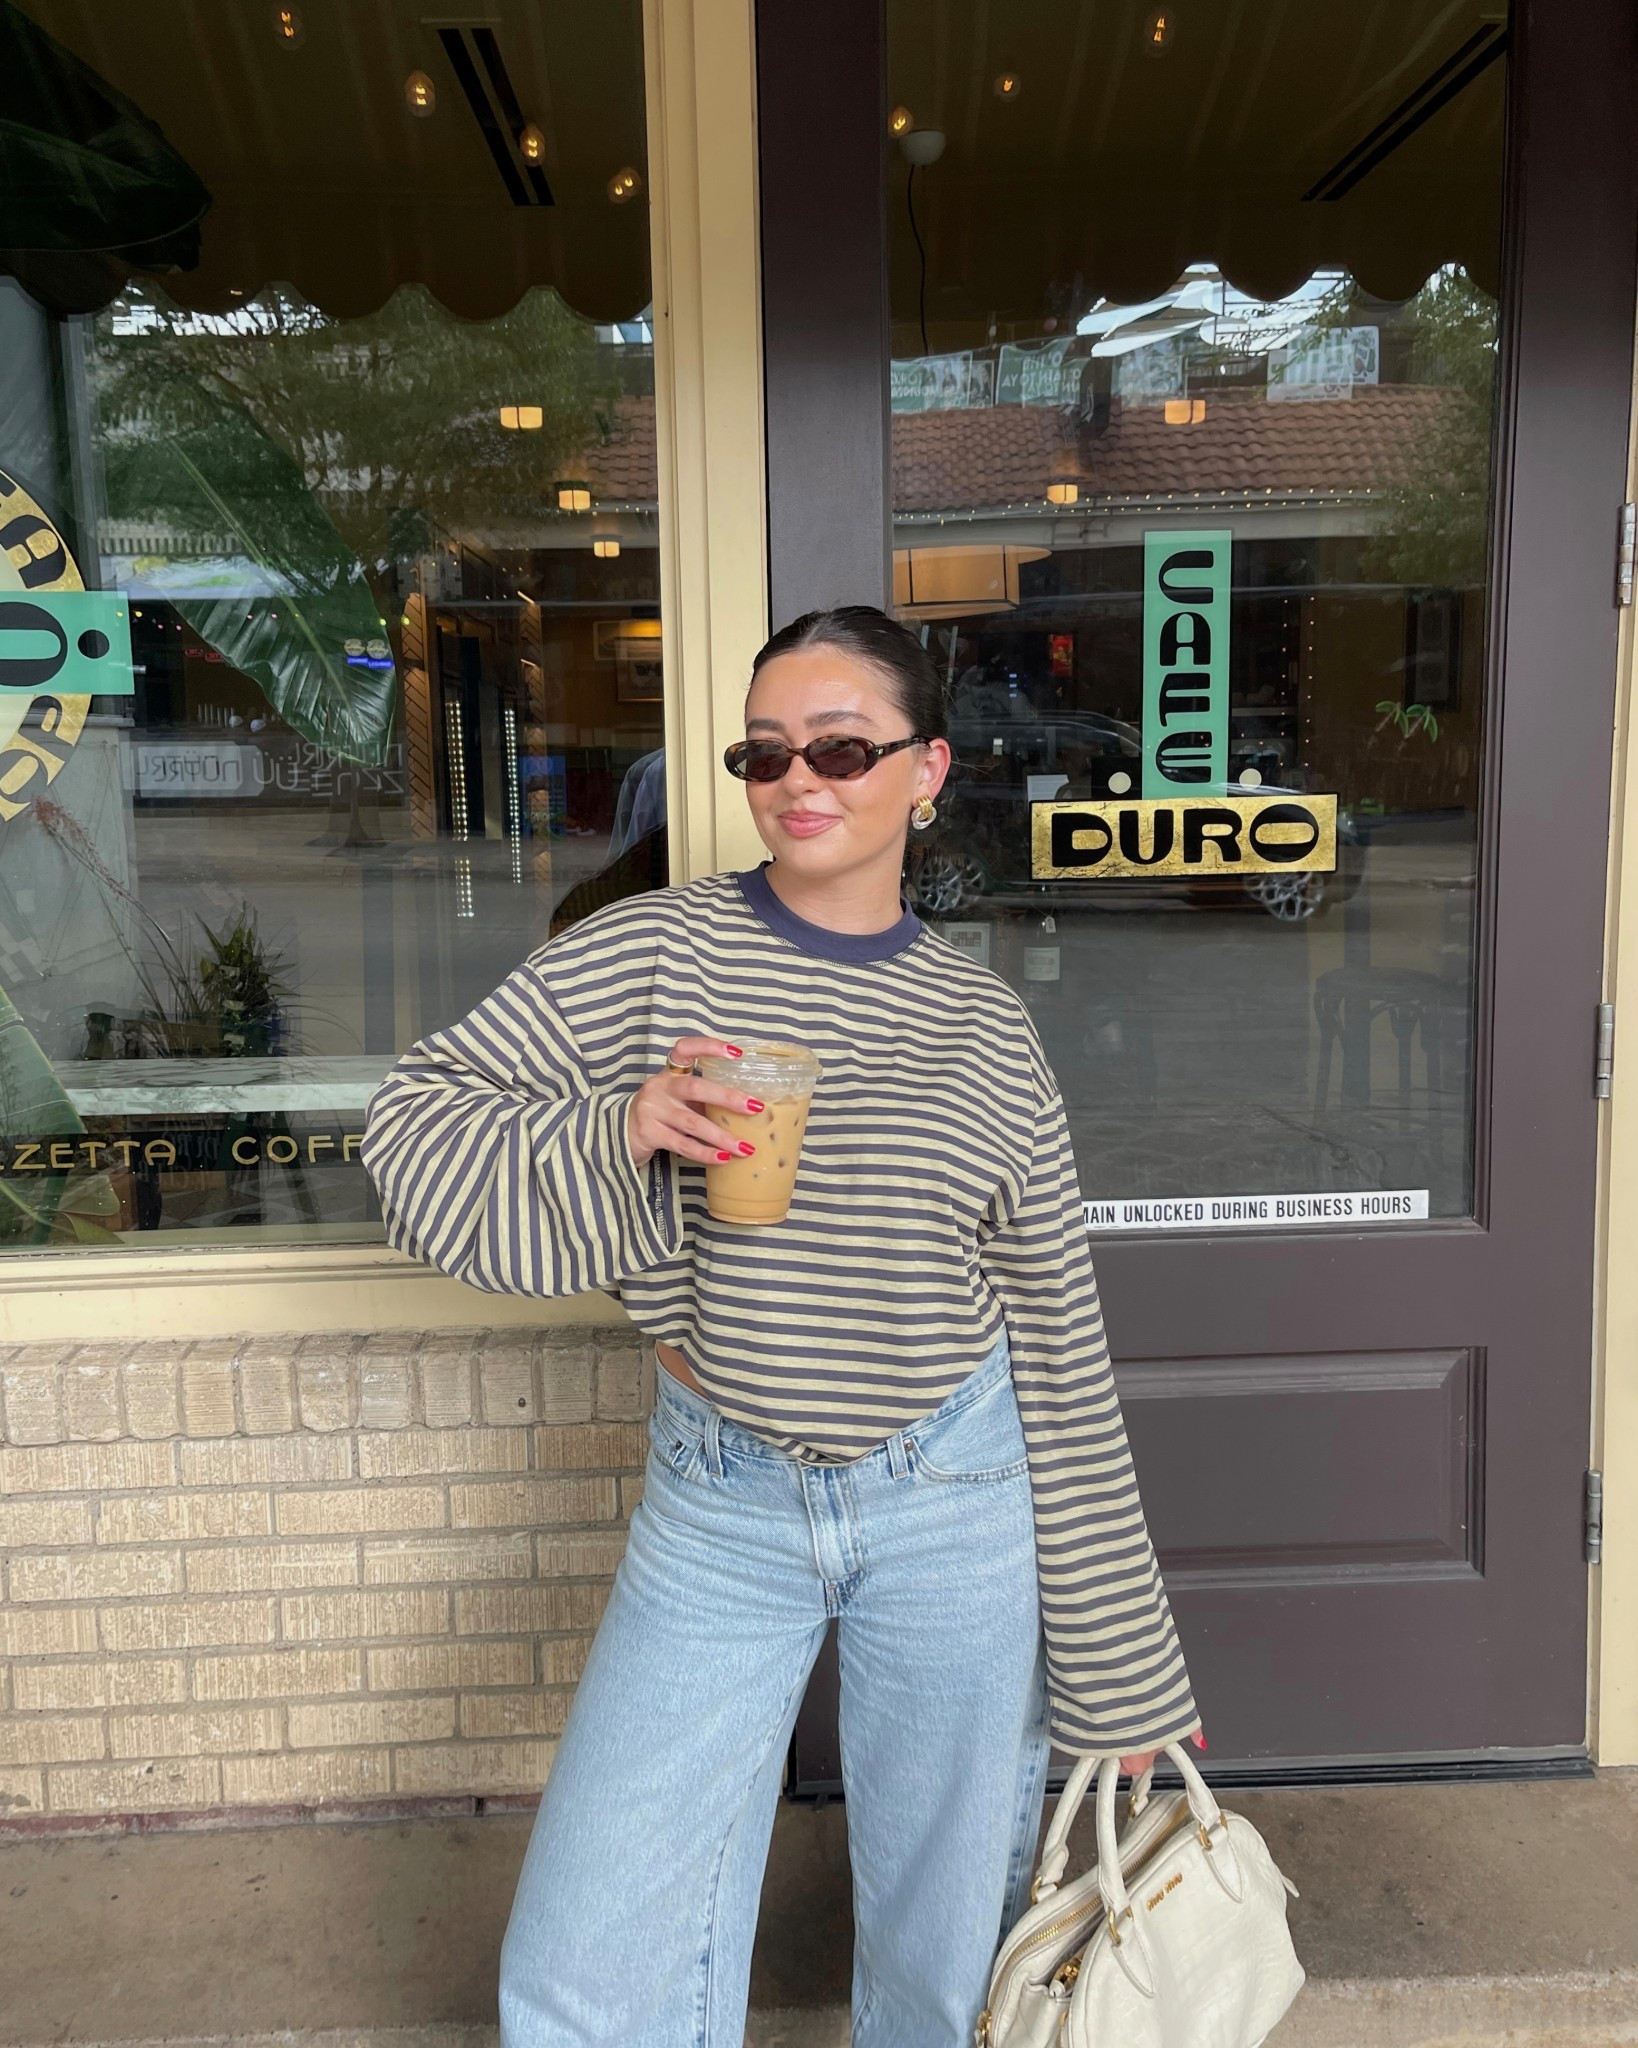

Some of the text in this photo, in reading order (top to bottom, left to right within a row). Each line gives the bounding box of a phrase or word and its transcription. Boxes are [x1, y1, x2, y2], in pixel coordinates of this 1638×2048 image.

[1155, 550, 1214, 784] CAFE
[1052, 803, 1320, 868] DURO
[0, 1139, 176, 1170] ZETTA
[232, 1134, 362, 1165] COFF
[1123, 1202, 1204, 1223] UNLOCKED
[1211, 1200, 1269, 1220] DURING
[1276, 1197, 1354, 1218] BUSINESS
[1361, 1195, 1413, 1215] HOURS
